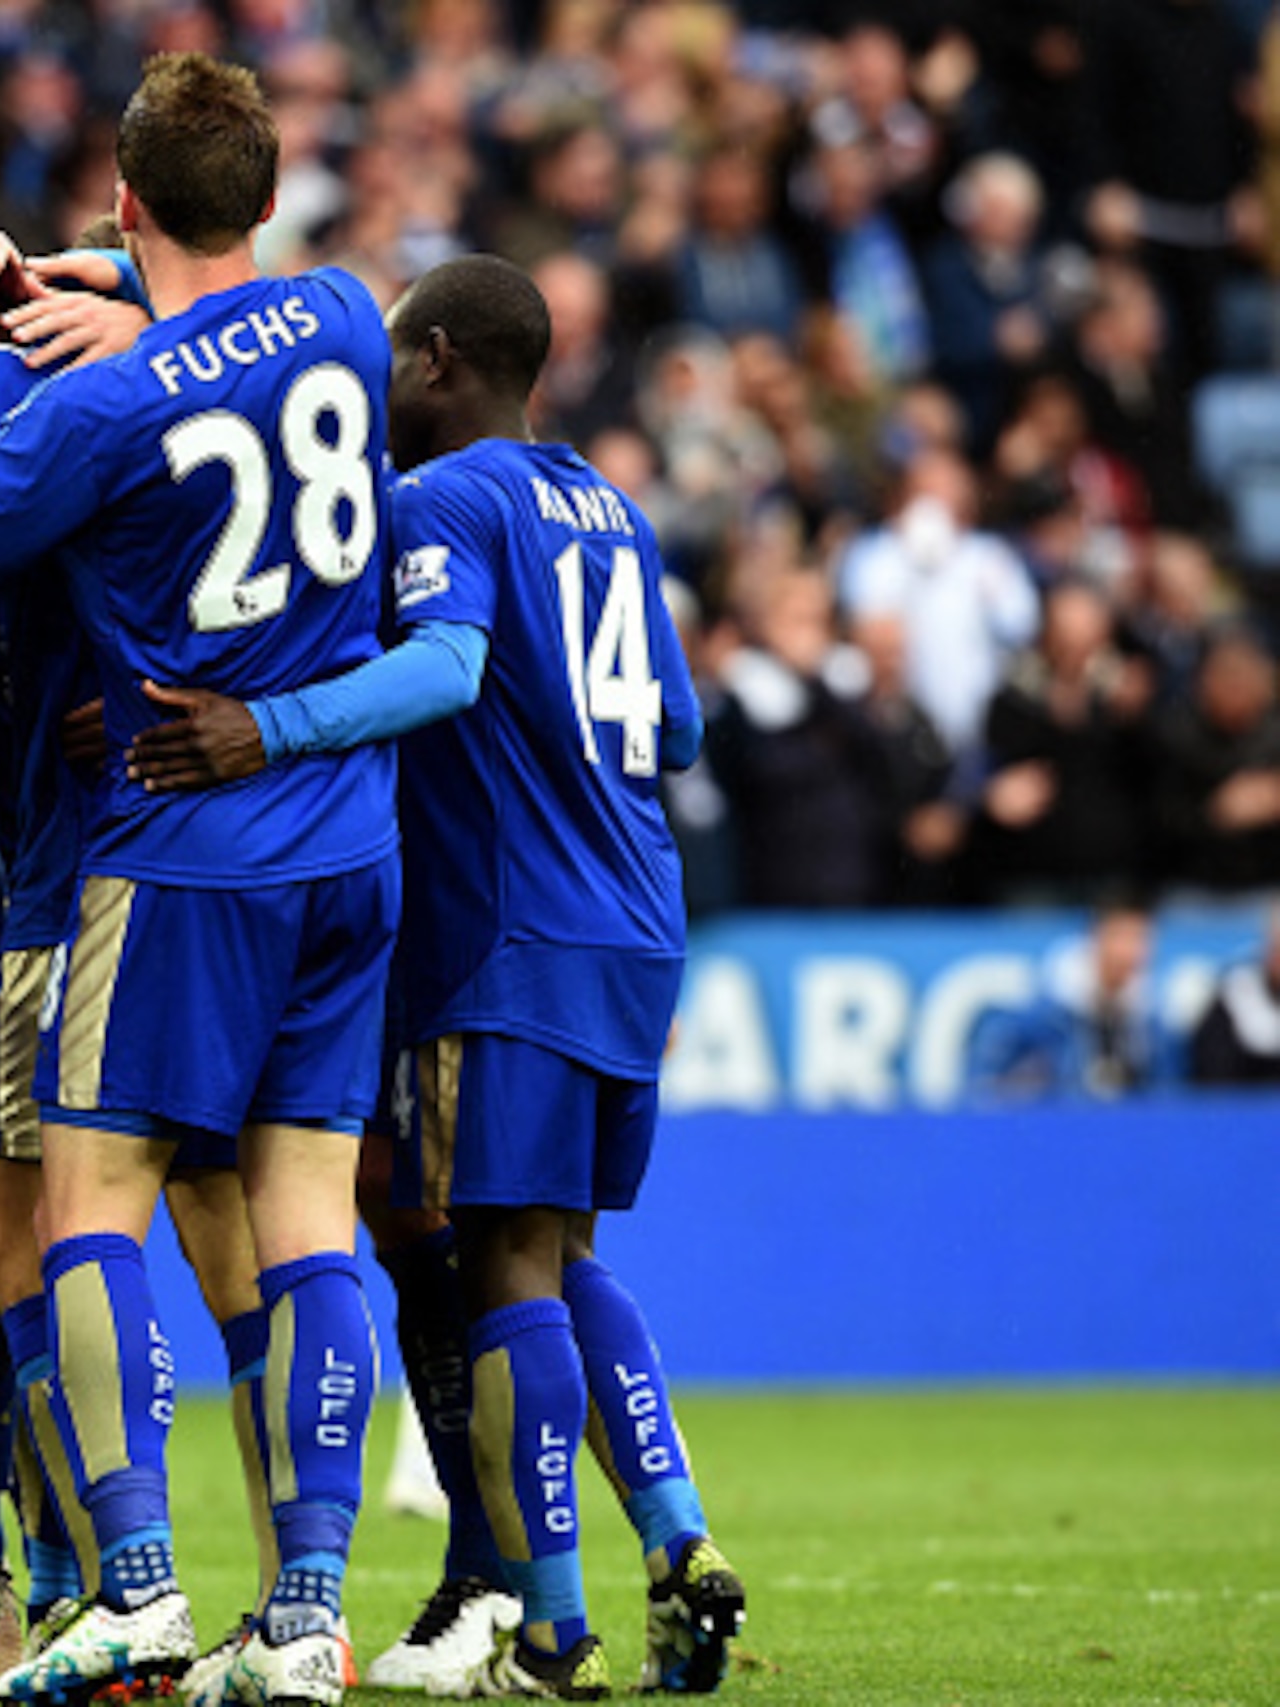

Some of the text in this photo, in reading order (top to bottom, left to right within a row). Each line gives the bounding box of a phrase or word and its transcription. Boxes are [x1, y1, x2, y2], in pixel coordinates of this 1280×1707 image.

[150, 296, 320, 395] FUCHS
[161, 361, 378, 633] 28
[553, 540, 662, 778] 14
[147, 1318, 175, 1426] LCFC
[316, 1346, 357, 1447] LCFC
[614, 1363, 672, 1473] LCFC
[536, 1422, 574, 1533] LCFC
